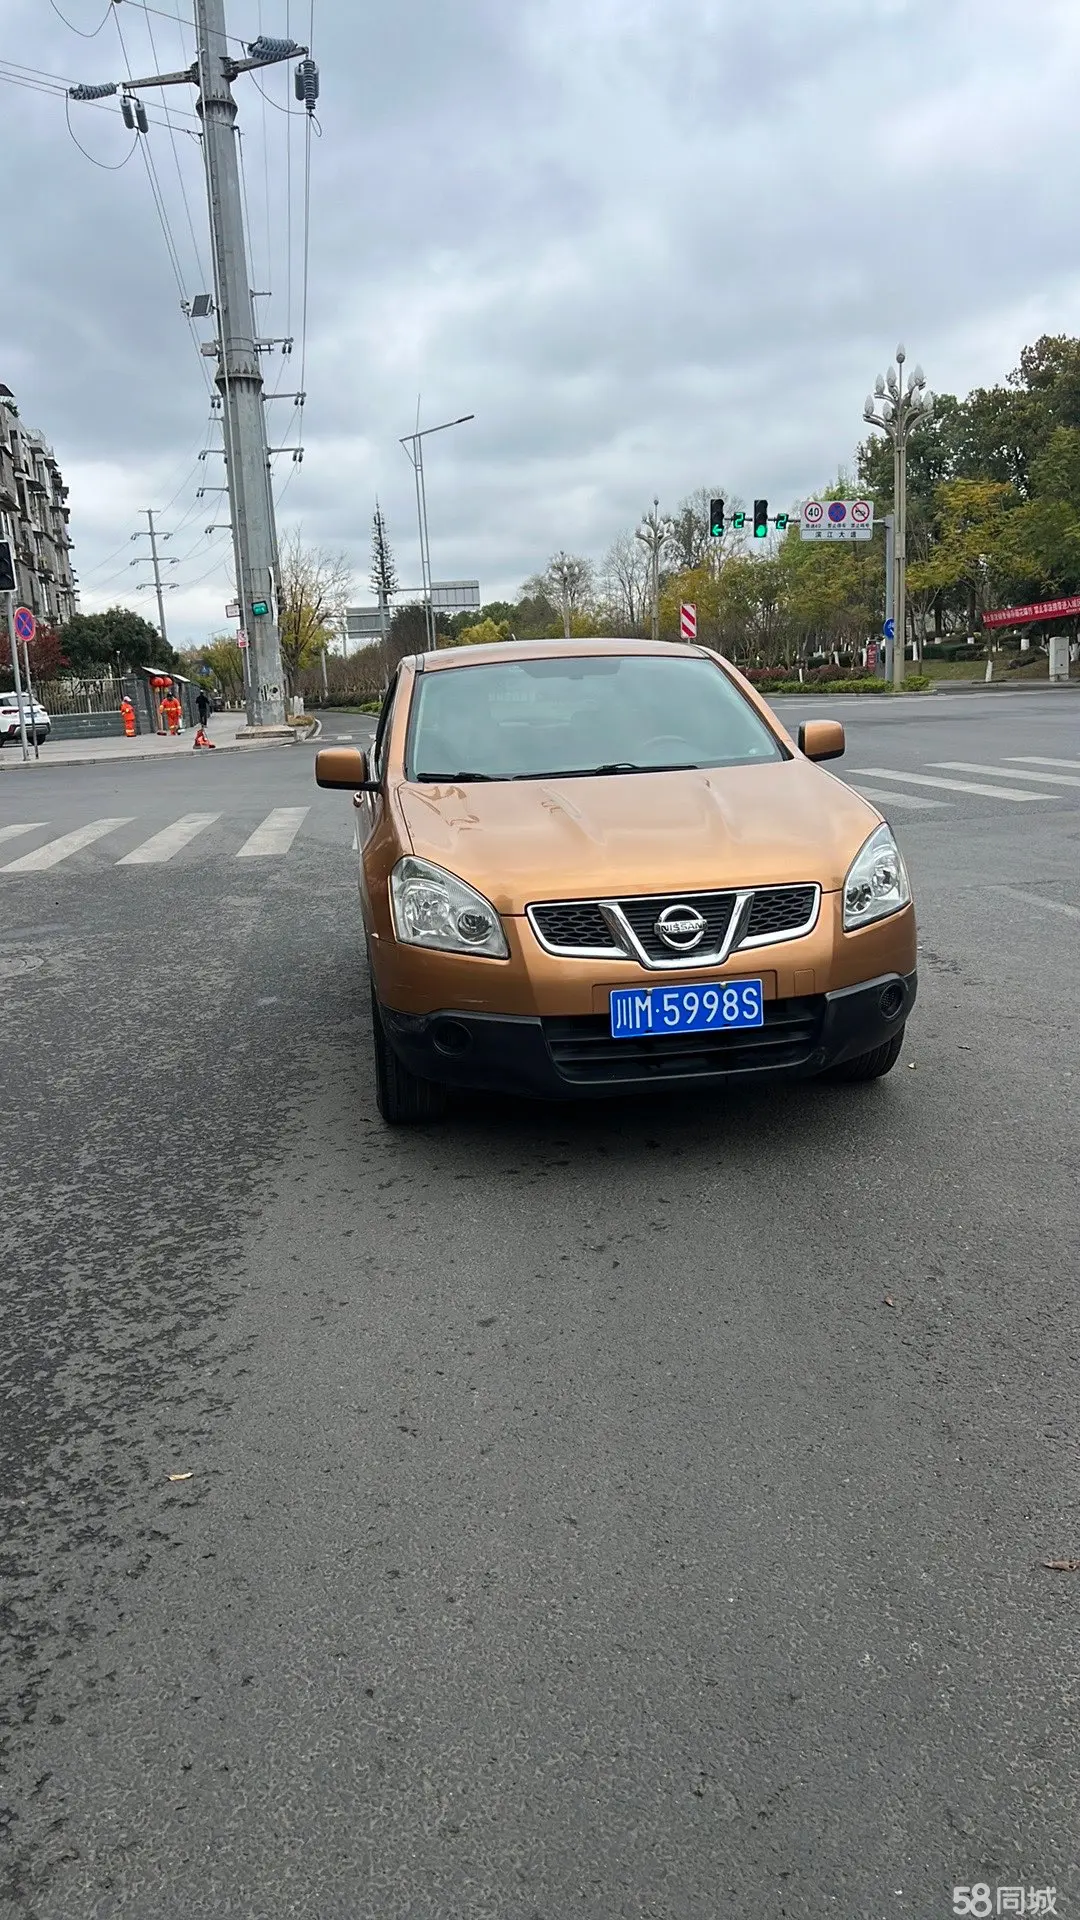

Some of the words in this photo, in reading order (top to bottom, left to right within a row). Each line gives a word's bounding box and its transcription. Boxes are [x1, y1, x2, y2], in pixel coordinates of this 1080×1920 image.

[734, 512, 744, 528] 2
[808, 507, 820, 517] 40
[777, 513, 788, 529] 2
[659, 920, 706, 934] NISSAN
[616, 987, 759, 1029] 川M·5998S
